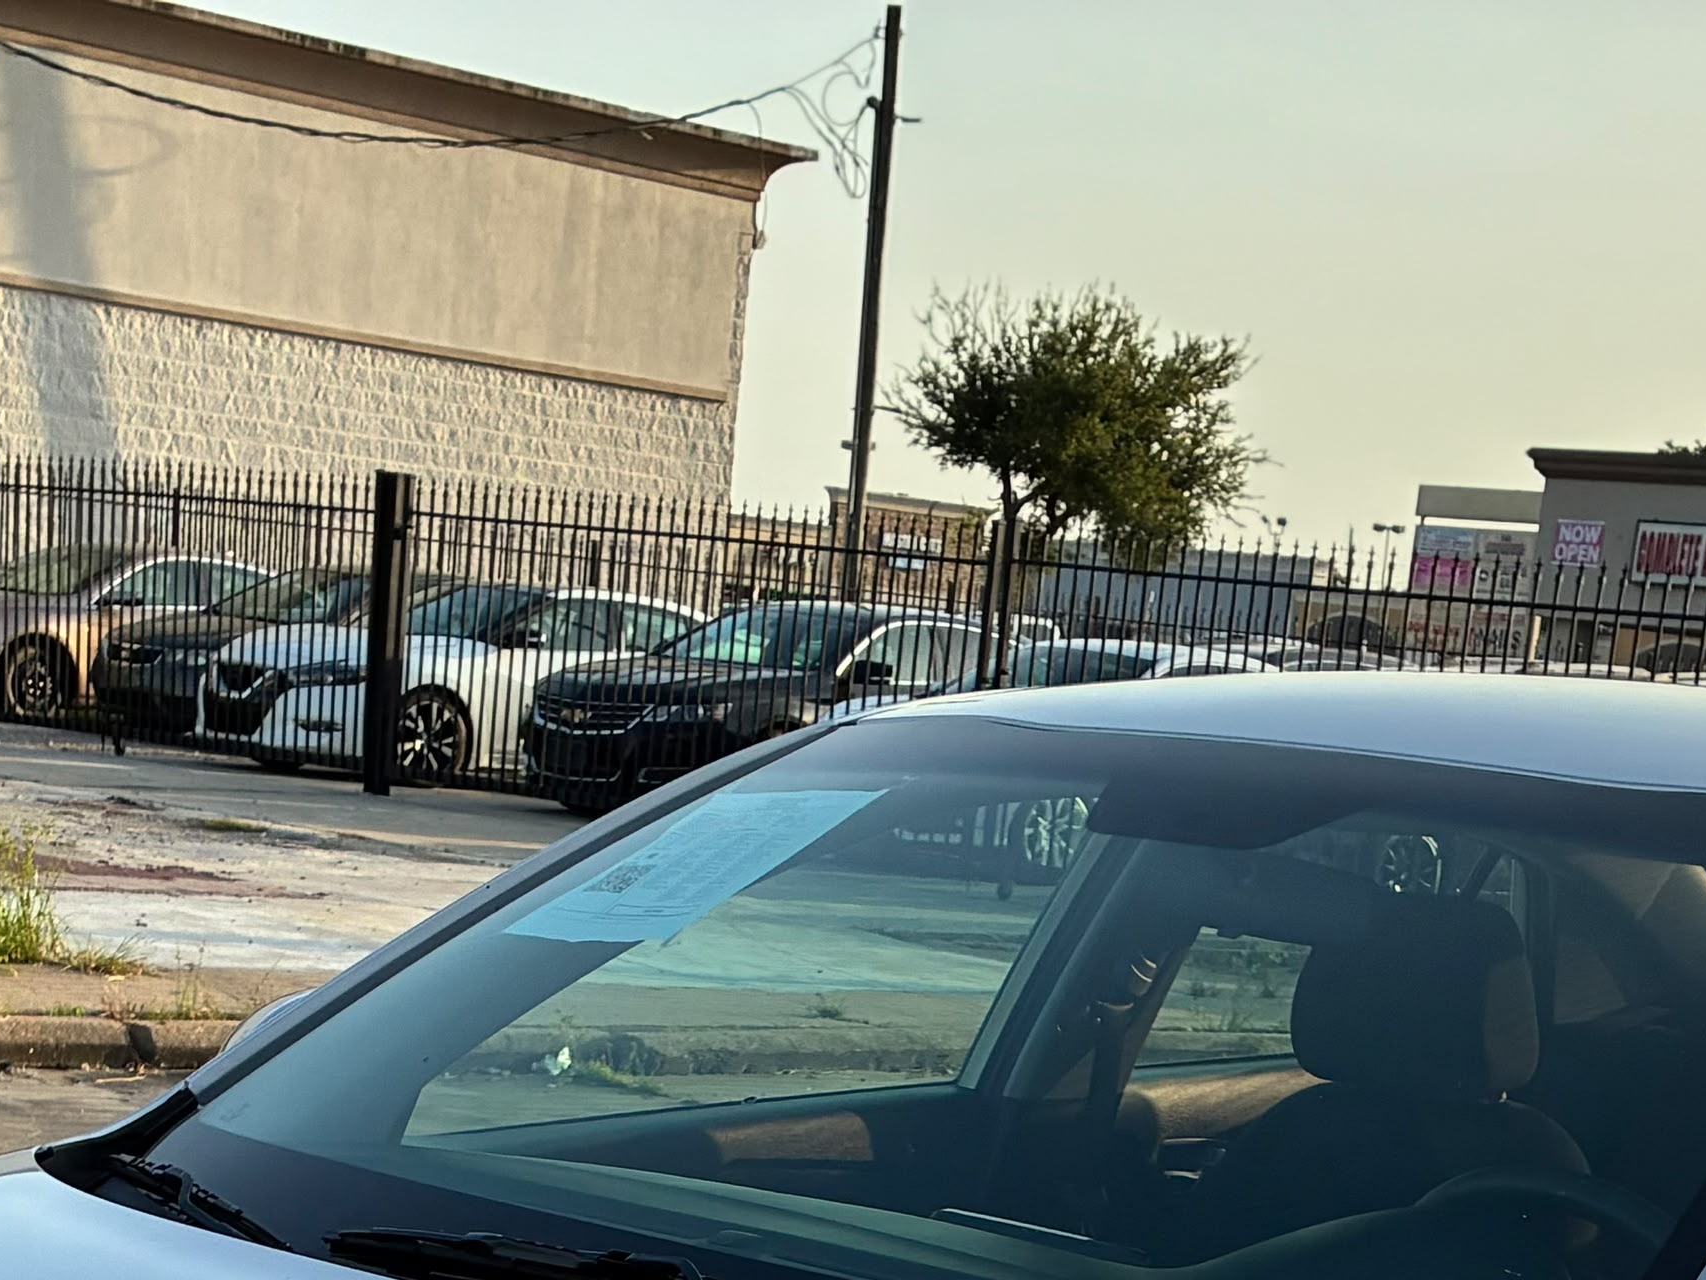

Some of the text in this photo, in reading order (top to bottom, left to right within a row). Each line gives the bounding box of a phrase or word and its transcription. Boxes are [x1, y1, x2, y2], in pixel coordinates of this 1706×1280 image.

[1559, 524, 1602, 544] NOW
[1554, 544, 1600, 563] OPEN
[1637, 531, 1703, 576] COMPLETE
